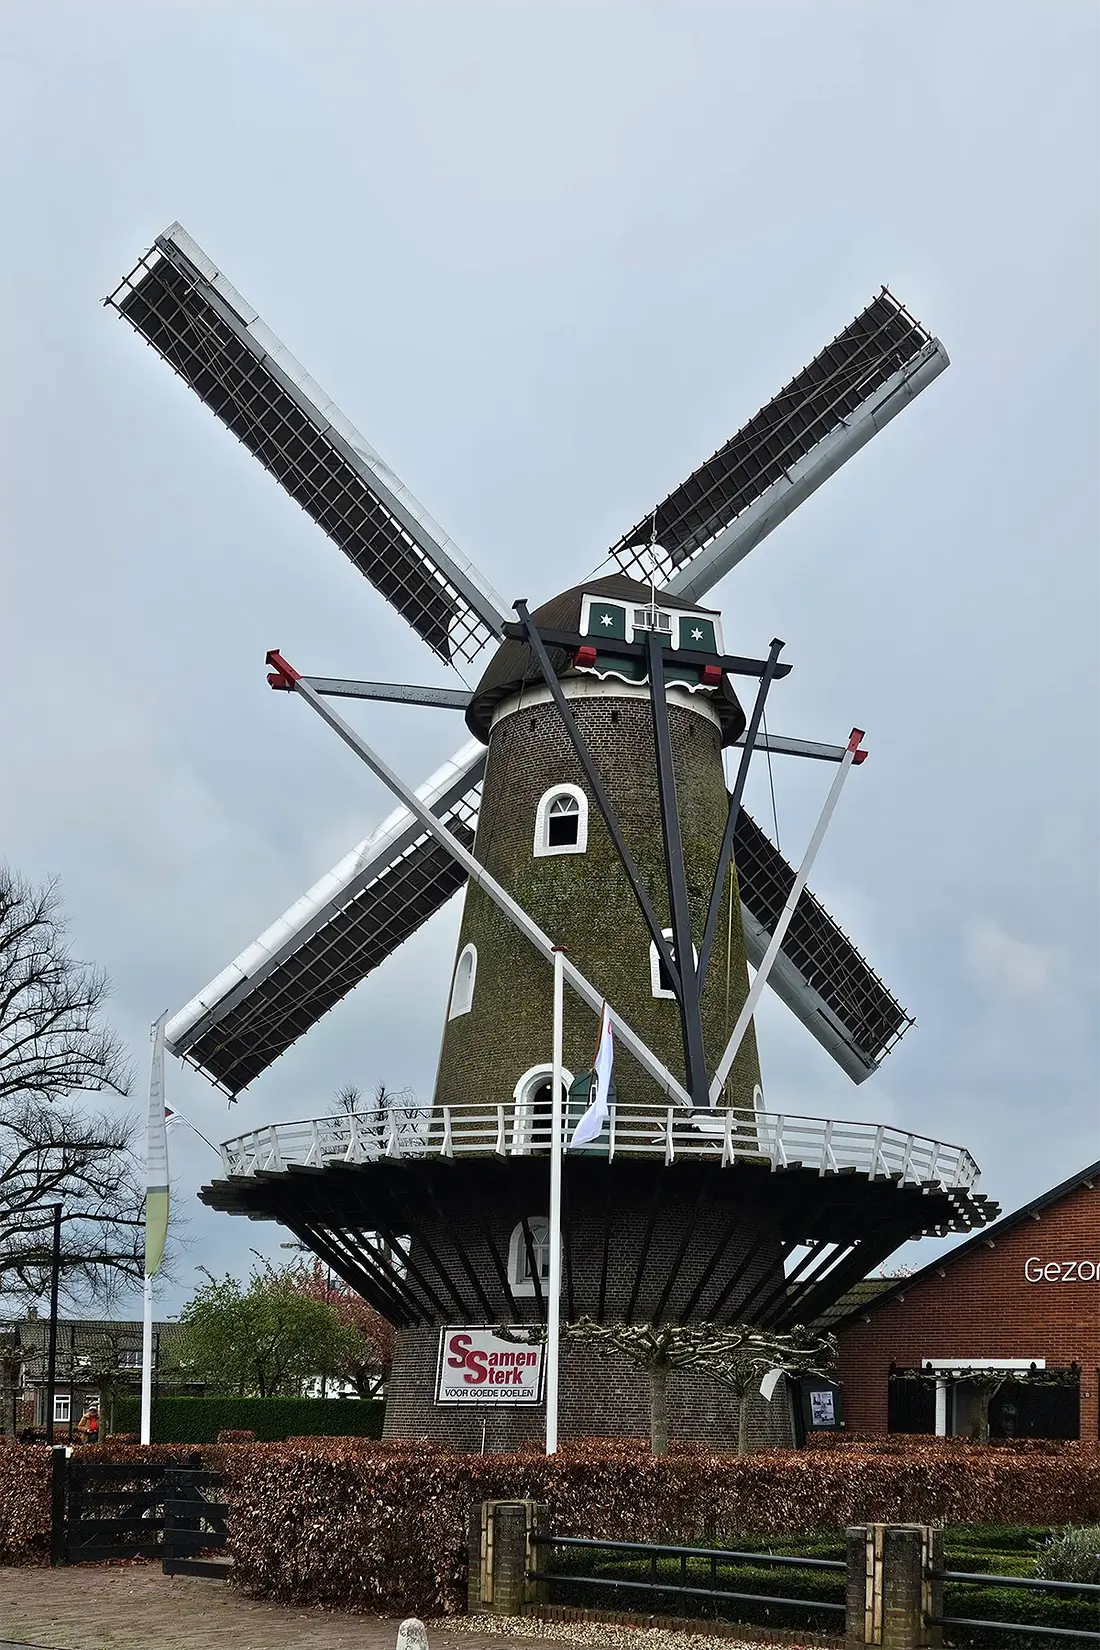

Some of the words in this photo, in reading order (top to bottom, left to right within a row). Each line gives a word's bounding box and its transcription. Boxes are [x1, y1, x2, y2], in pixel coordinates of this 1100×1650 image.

[448, 1334, 537, 1368] Samen
[463, 1350, 524, 1384] Sterk
[445, 1389, 468, 1397] VOOR
[470, 1389, 498, 1397] GOEDE
[501, 1389, 534, 1397] DOELEN
